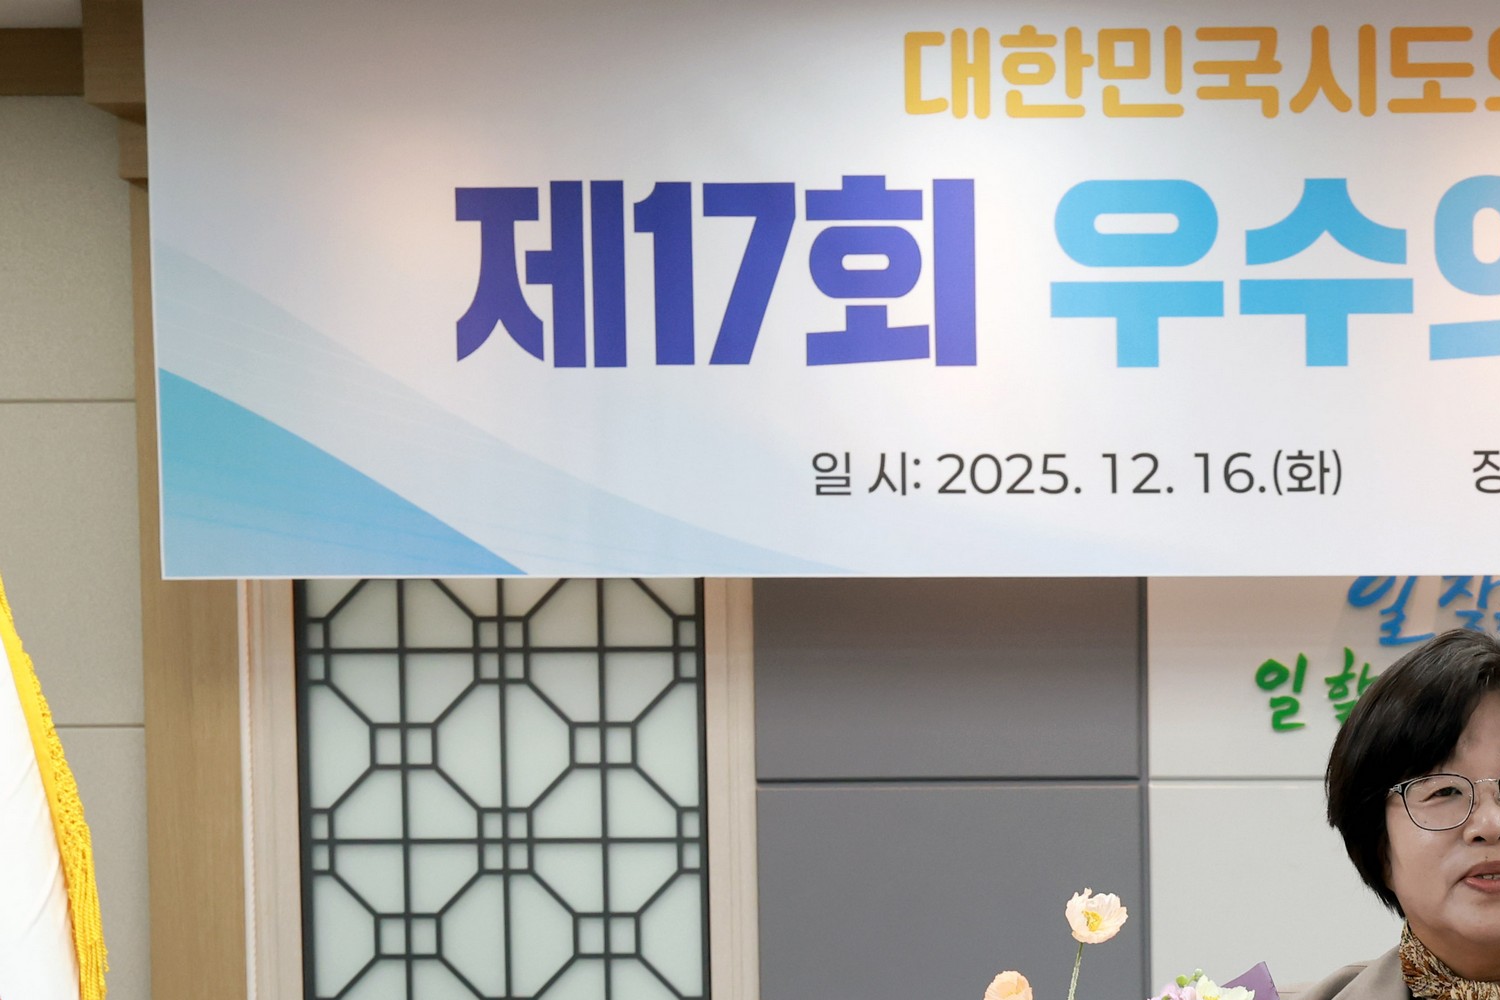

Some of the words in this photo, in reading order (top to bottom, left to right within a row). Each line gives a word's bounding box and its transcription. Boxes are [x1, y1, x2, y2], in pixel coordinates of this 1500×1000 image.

[454, 175, 978, 368] 제17회
[812, 451, 852, 496] 일
[868, 451, 922, 496] 시:
[937, 453, 1083, 495] 2025.
[1101, 452, 1175, 494] 12.
[1194, 449, 1343, 496] 16.(화)
[1255, 652, 1306, 732] 일
